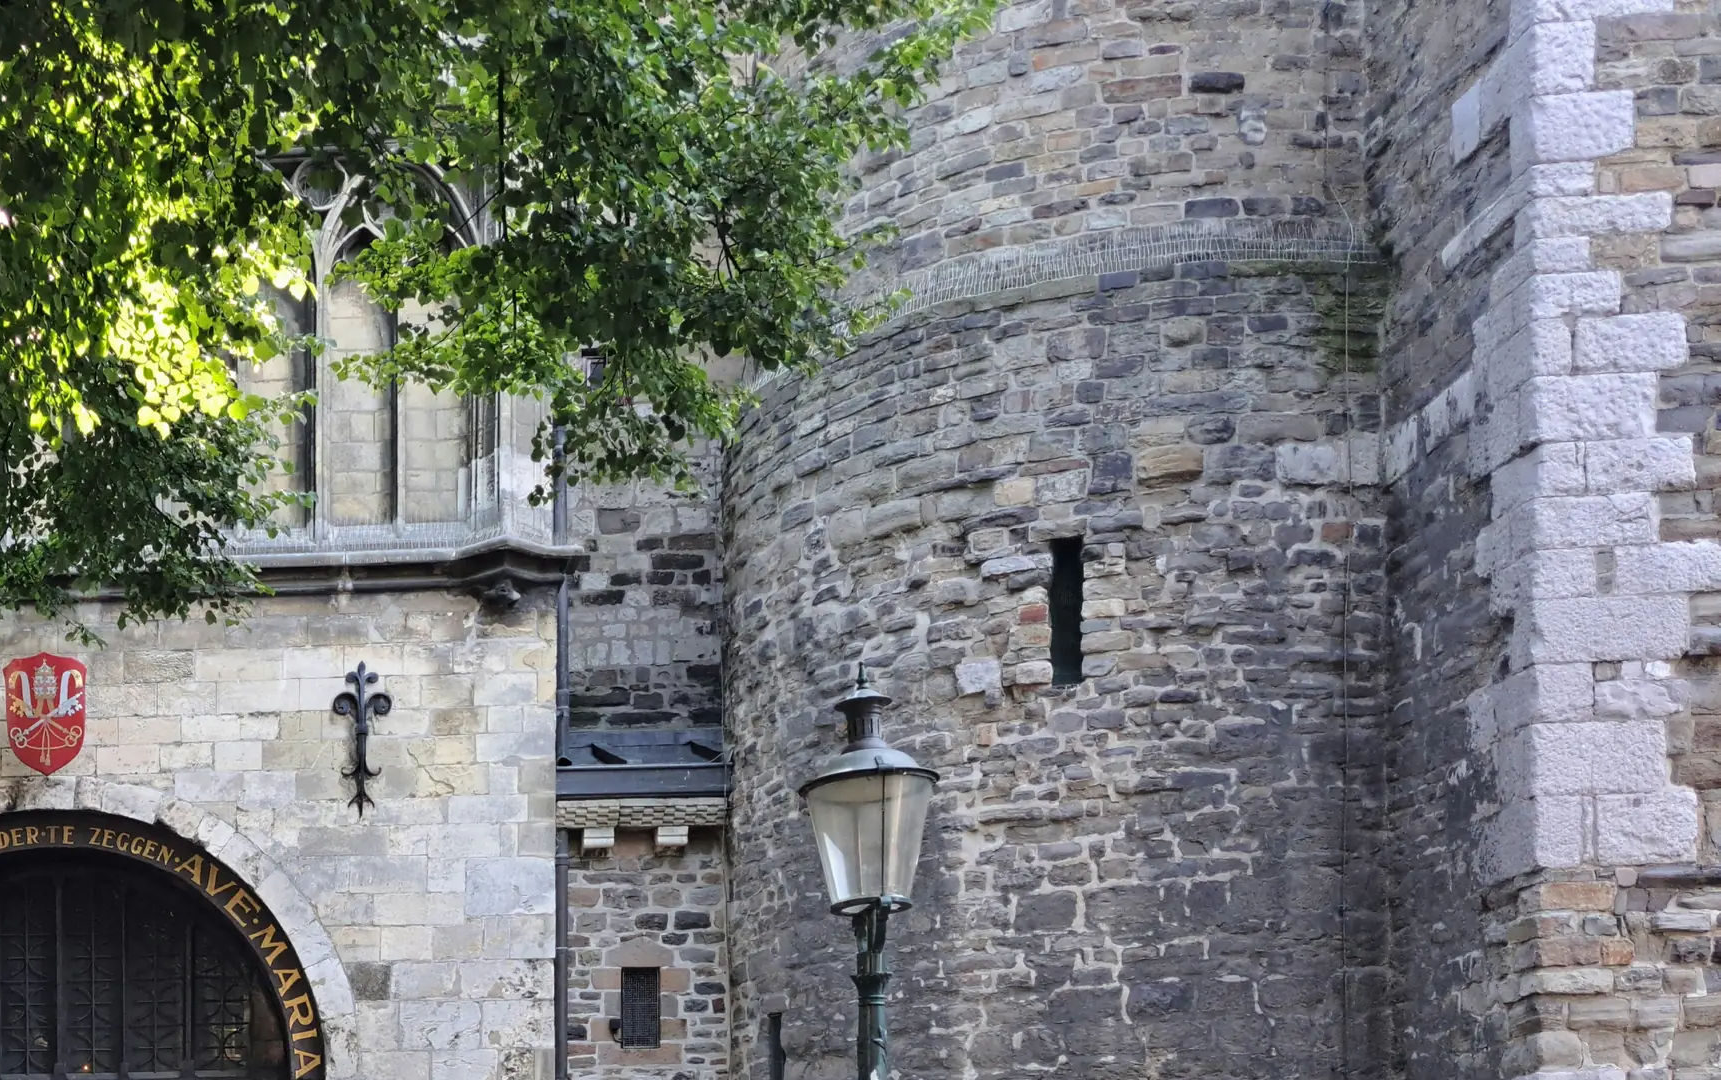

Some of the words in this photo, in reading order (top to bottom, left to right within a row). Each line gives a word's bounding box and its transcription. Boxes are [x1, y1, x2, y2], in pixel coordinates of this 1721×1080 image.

[46, 825, 75, 845] TE
[89, 827, 174, 866] ZEGGEN
[174, 854, 261, 928] AVE
[248, 924, 321, 1080] MARIA
